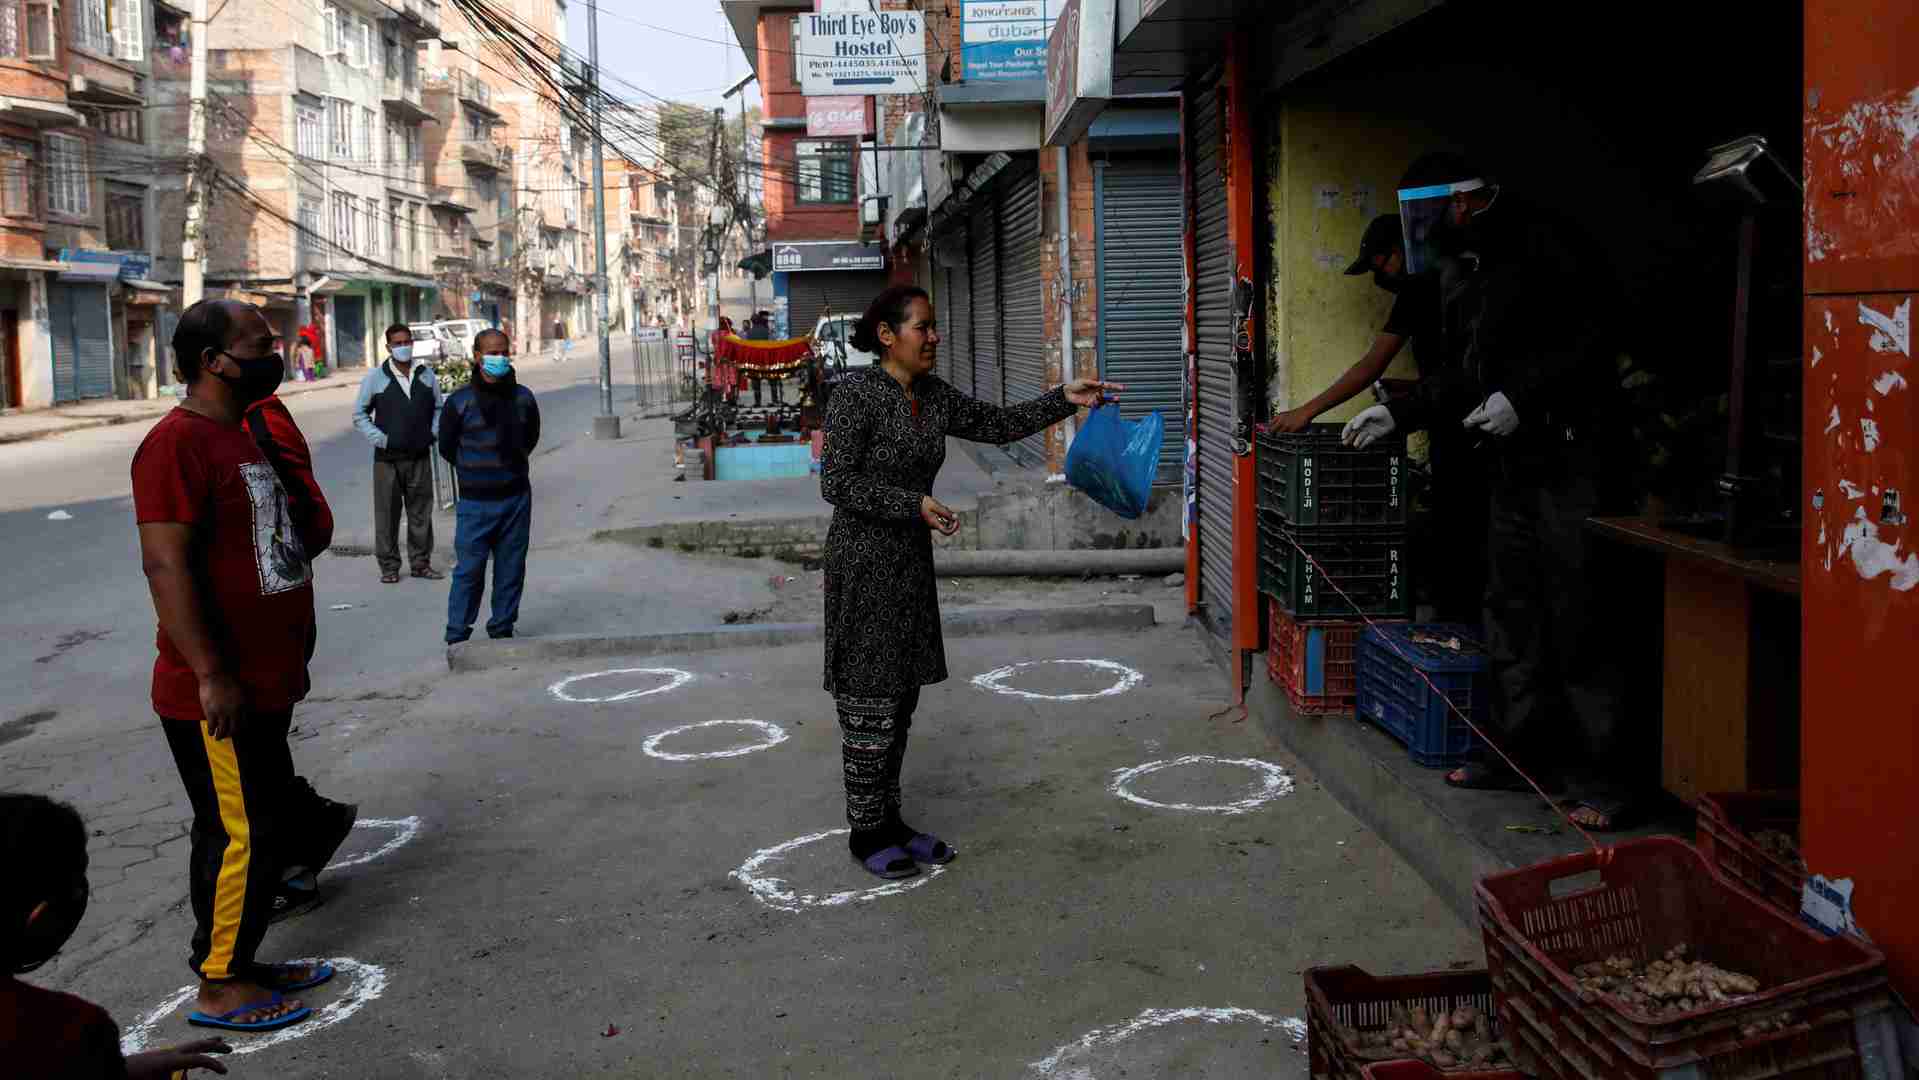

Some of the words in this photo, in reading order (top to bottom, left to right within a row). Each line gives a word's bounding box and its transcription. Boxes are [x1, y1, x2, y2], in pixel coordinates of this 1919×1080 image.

[809, 14, 846, 36] Third
[852, 14, 876, 39] Eye
[881, 13, 917, 38] Boy's
[835, 40, 892, 56] Hostel
[1389, 549, 1400, 600] RAJA
